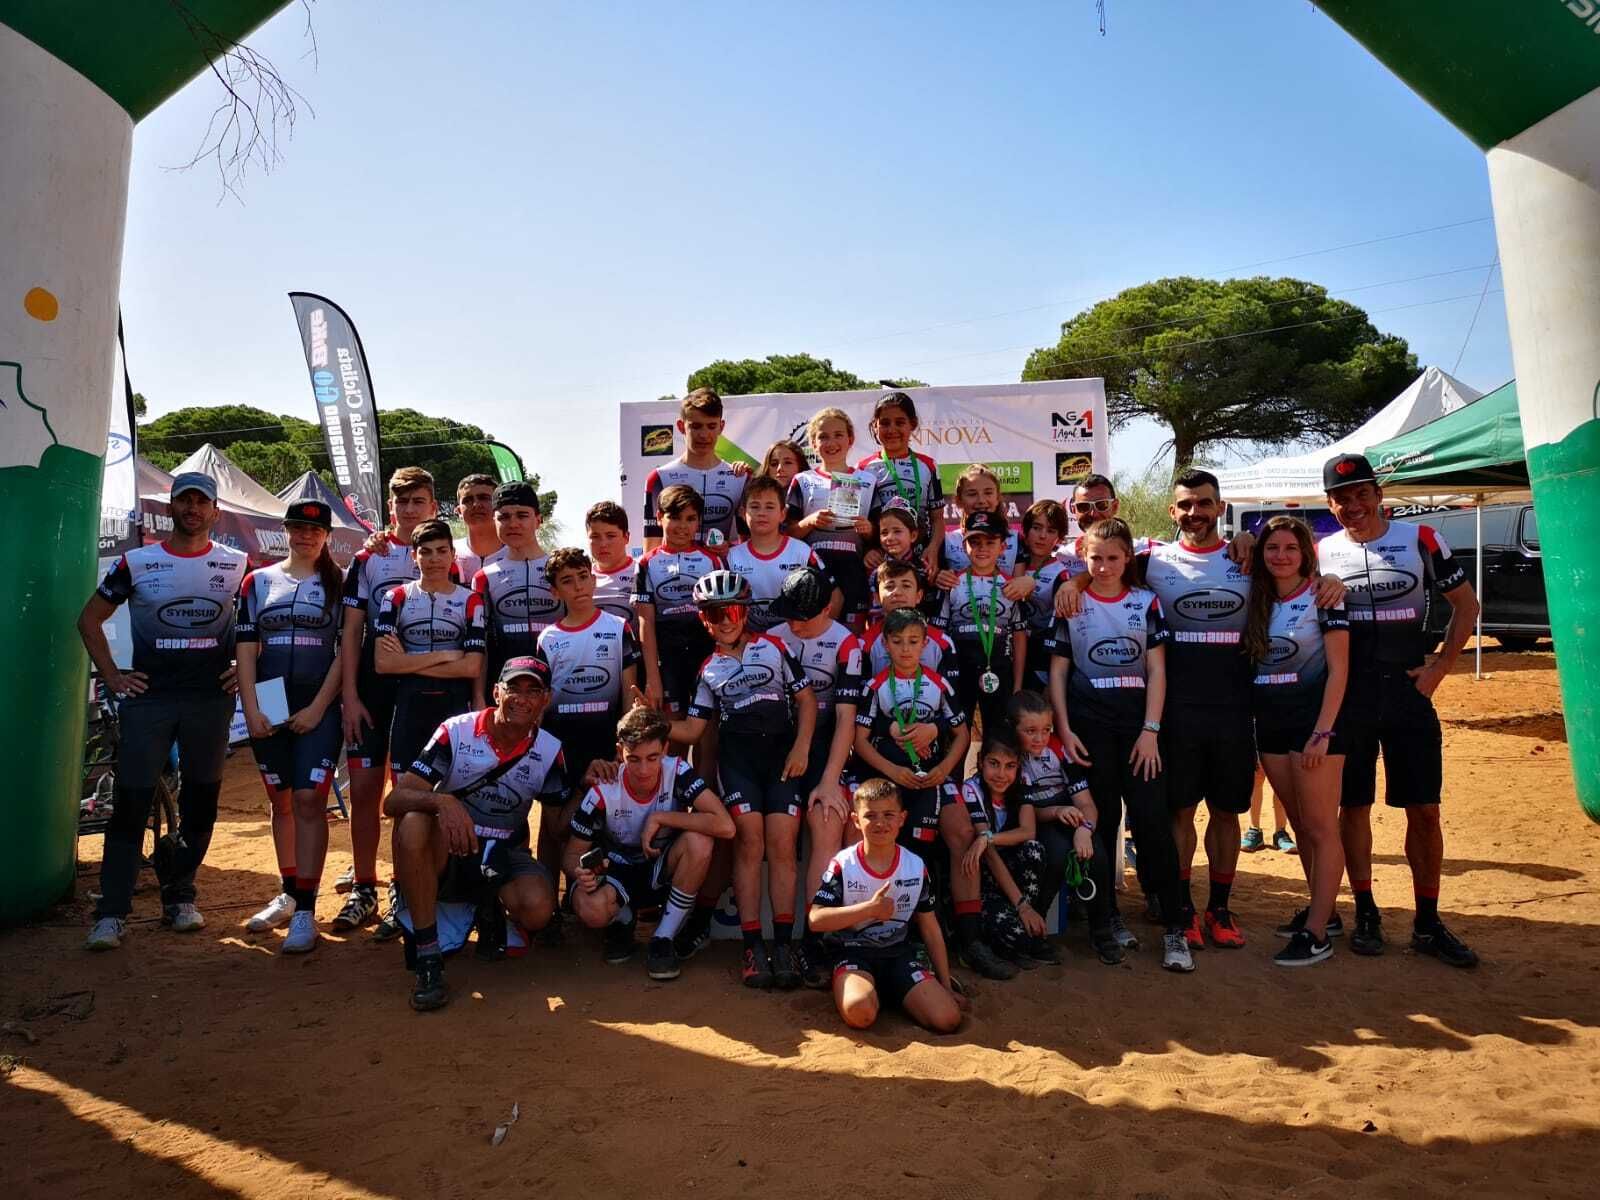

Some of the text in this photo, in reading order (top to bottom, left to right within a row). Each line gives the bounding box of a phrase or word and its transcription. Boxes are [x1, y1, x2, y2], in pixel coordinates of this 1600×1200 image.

[910, 427, 992, 444] NNOVA
[1348, 581, 1407, 592] YMISUR
[1182, 600, 1236, 609] SYMISUR
[166, 608, 216, 618] SYMISUR
